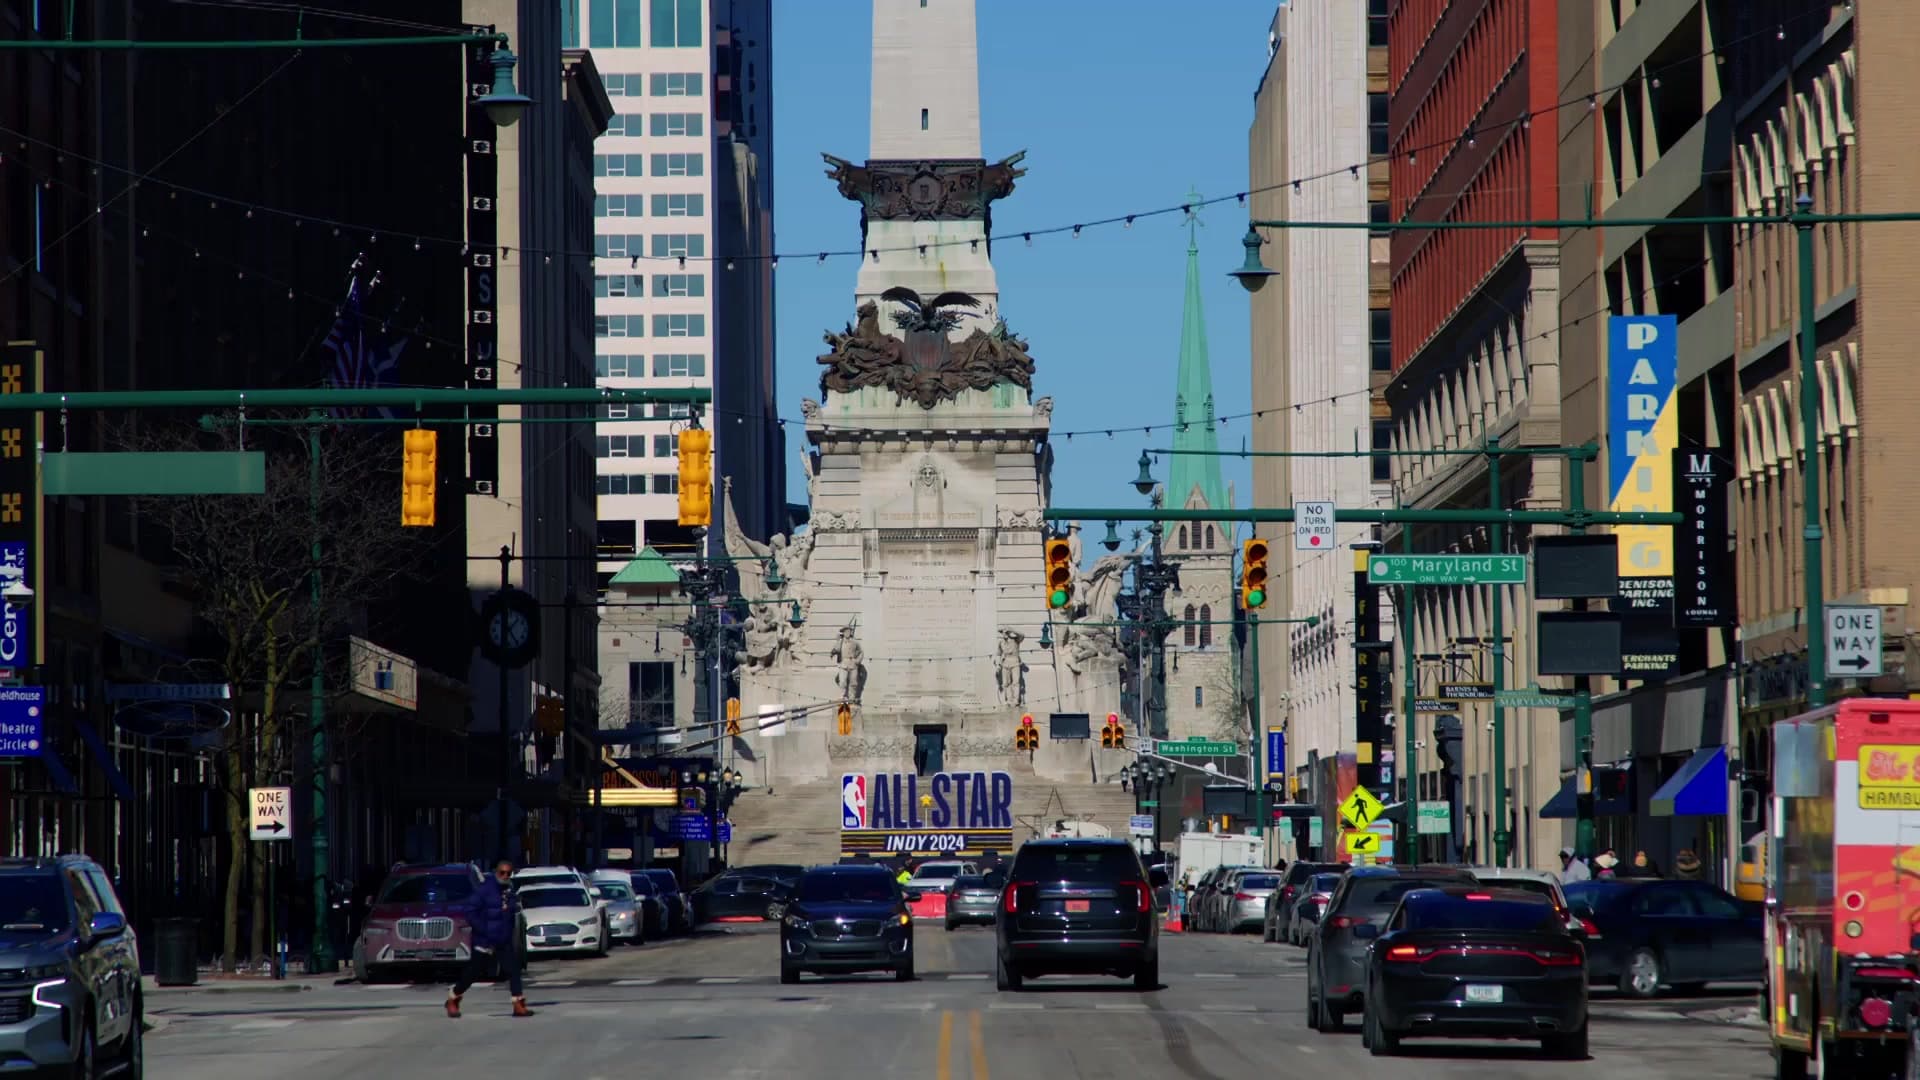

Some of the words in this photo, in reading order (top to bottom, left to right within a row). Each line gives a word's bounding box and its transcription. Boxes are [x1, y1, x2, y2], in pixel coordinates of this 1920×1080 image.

[1626, 323, 1662, 568] PARKING
[1306, 505, 1323, 514] NO
[1299, 526, 1311, 534] ON
[1314, 526, 1331, 534] RED
[1695, 489, 1706, 605] MORRISON
[1390, 558, 1407, 566] 100
[1412, 558, 1492, 574] Maryland
[1501, 559, 1518, 571] St
[1395, 570, 1401, 580] S
[1632, 599, 1660, 607] INC.
[1835, 615, 1874, 629] ONE
[1833, 636, 1876, 651] WAY
[1358, 599, 1369, 714] FIRST
[1624, 662, 1668, 670] PARKING
[1499, 697, 1561, 706] MARYLAND
[1161, 744, 1219, 754] Washington
[1222, 745, 1233, 753] St
[257, 791, 283, 803] ONE
[871, 773, 924, 829] ALL
[931, 772, 1012, 829] STAR
[257, 805, 284, 817] WAY
[886, 835, 929, 851] INDY
[929, 835, 965, 850] 2024
